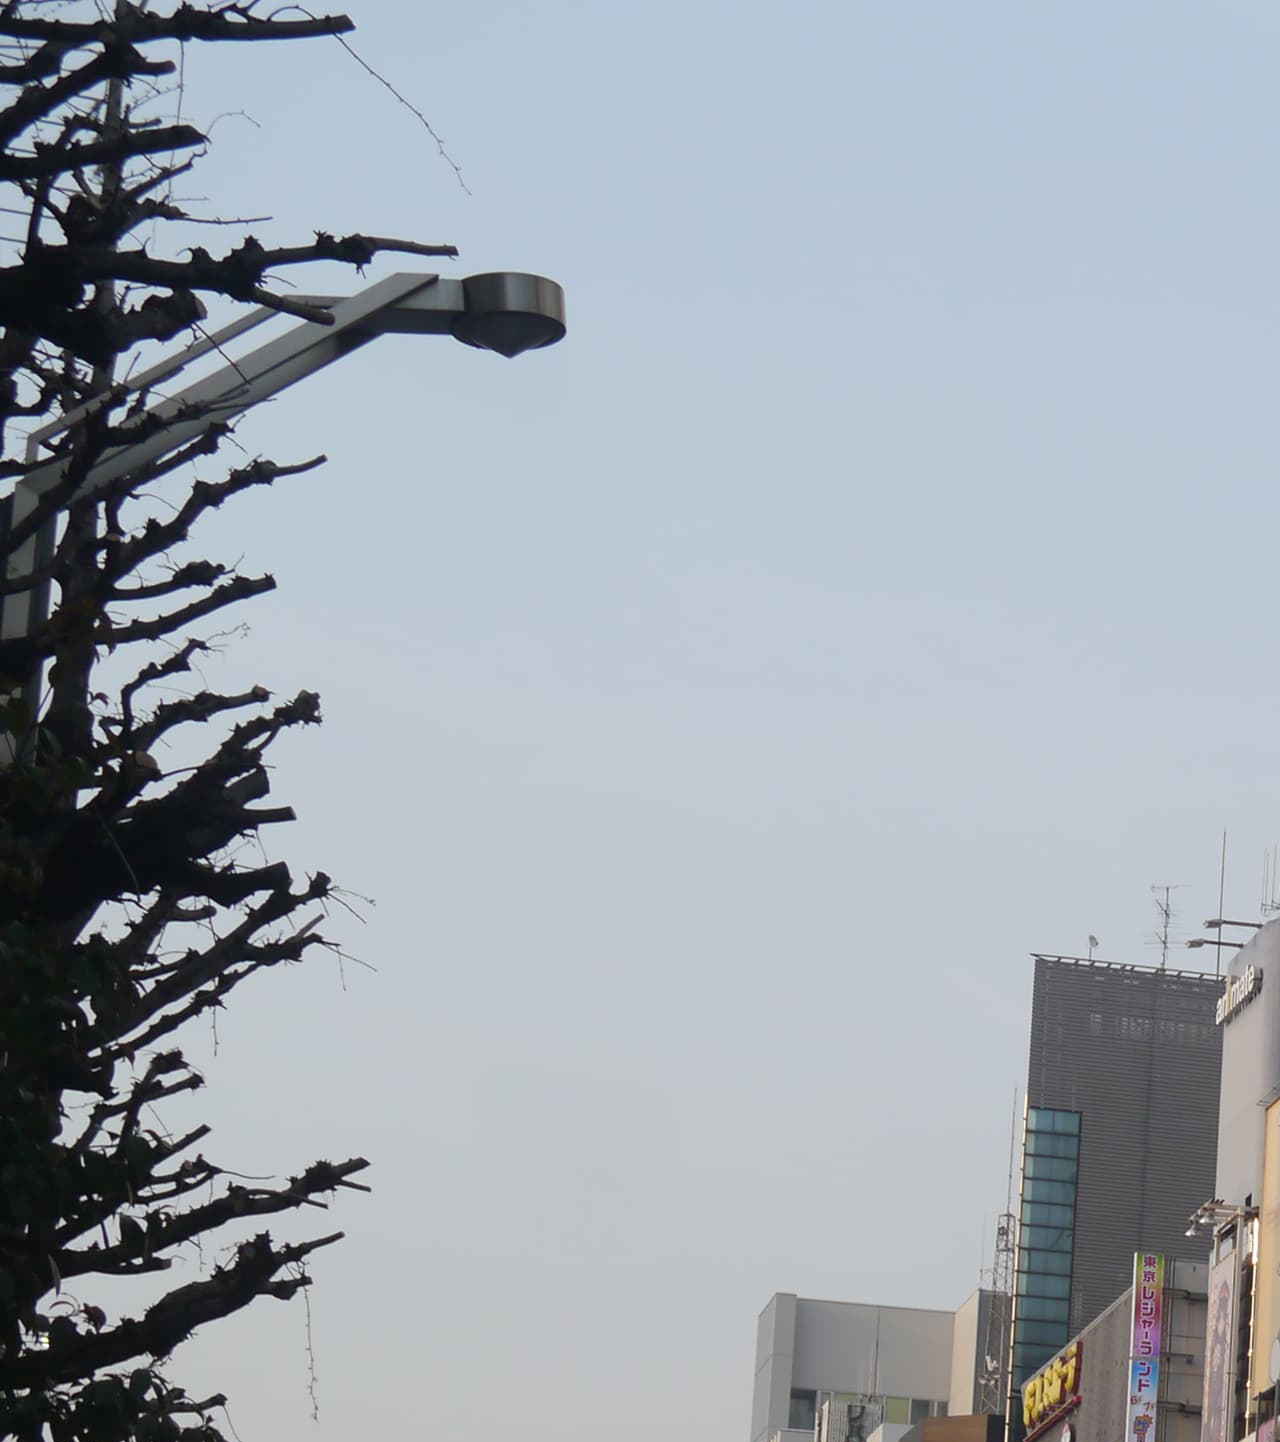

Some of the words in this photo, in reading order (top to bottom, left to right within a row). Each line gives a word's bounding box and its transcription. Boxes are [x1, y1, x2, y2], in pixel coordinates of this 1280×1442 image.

[1137, 1255, 1158, 1393] 東京レジャーランド
